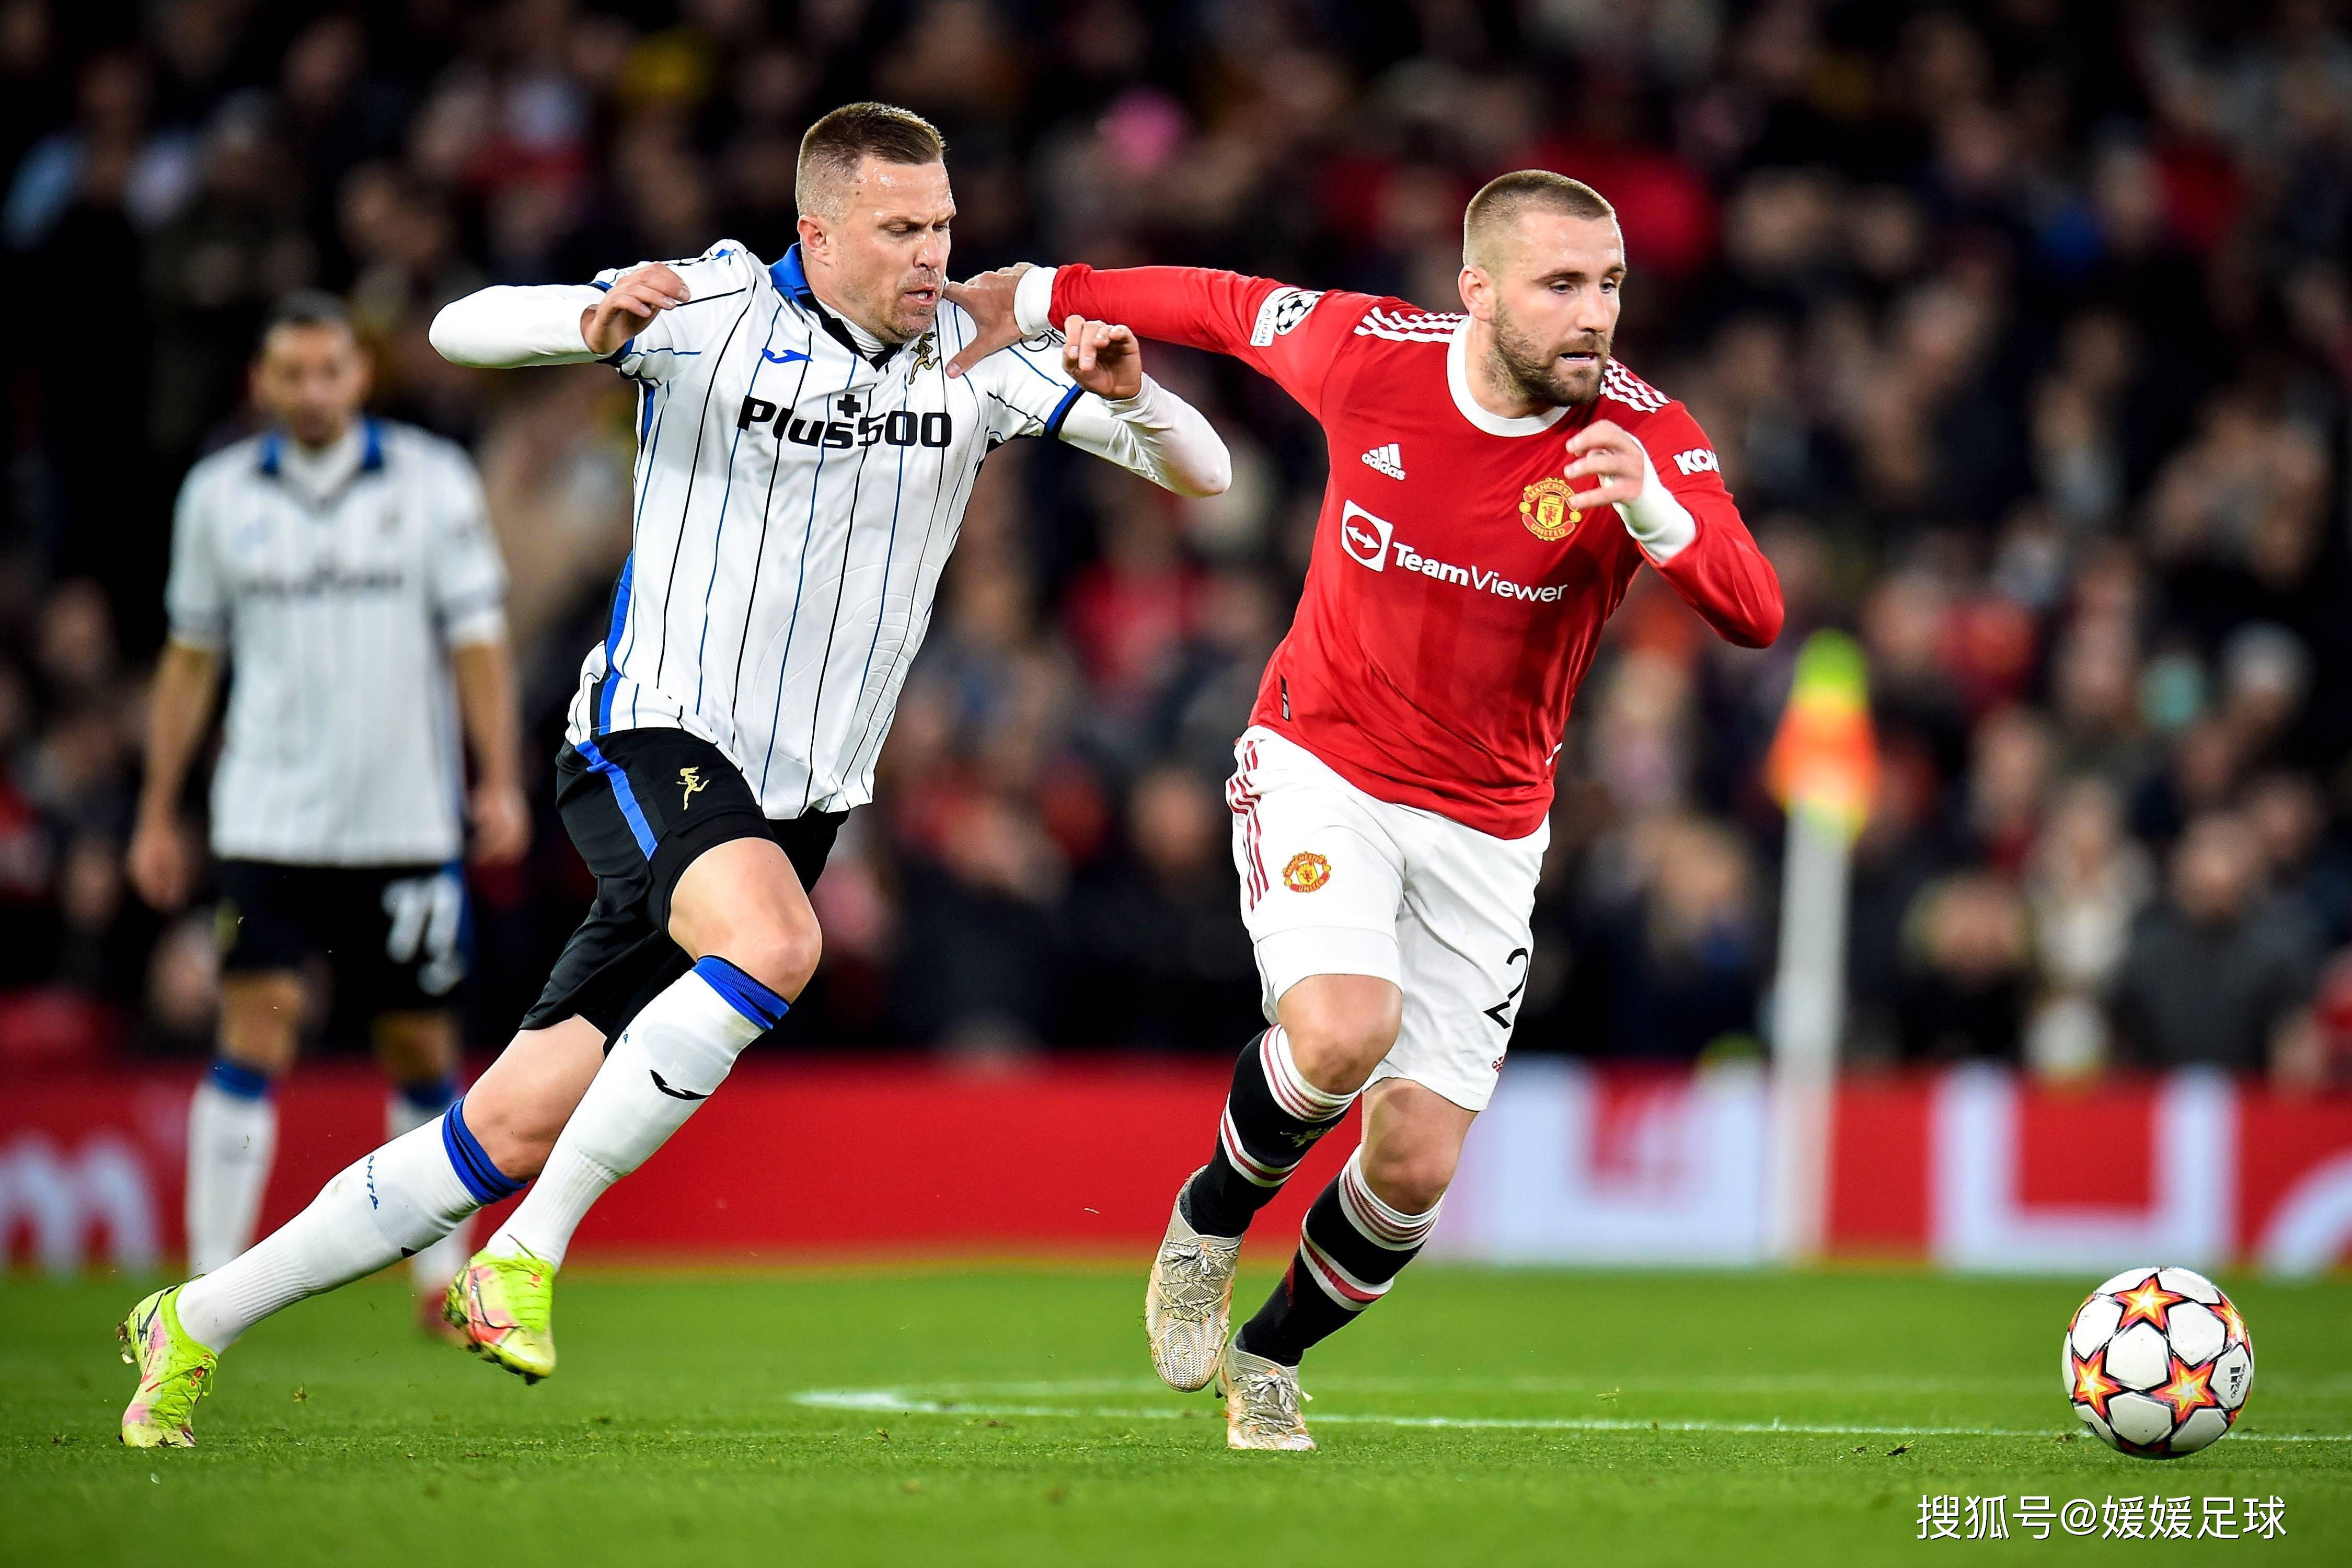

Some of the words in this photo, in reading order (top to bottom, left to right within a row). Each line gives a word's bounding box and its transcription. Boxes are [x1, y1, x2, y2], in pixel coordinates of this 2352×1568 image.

[737, 395, 952, 448] Plus500
[1361, 453, 1405, 480] adidas
[1527, 482, 1574, 500] MANCHEST
[1530, 522, 1566, 537] UNITED
[1392, 541, 1567, 603] TeamViewer
